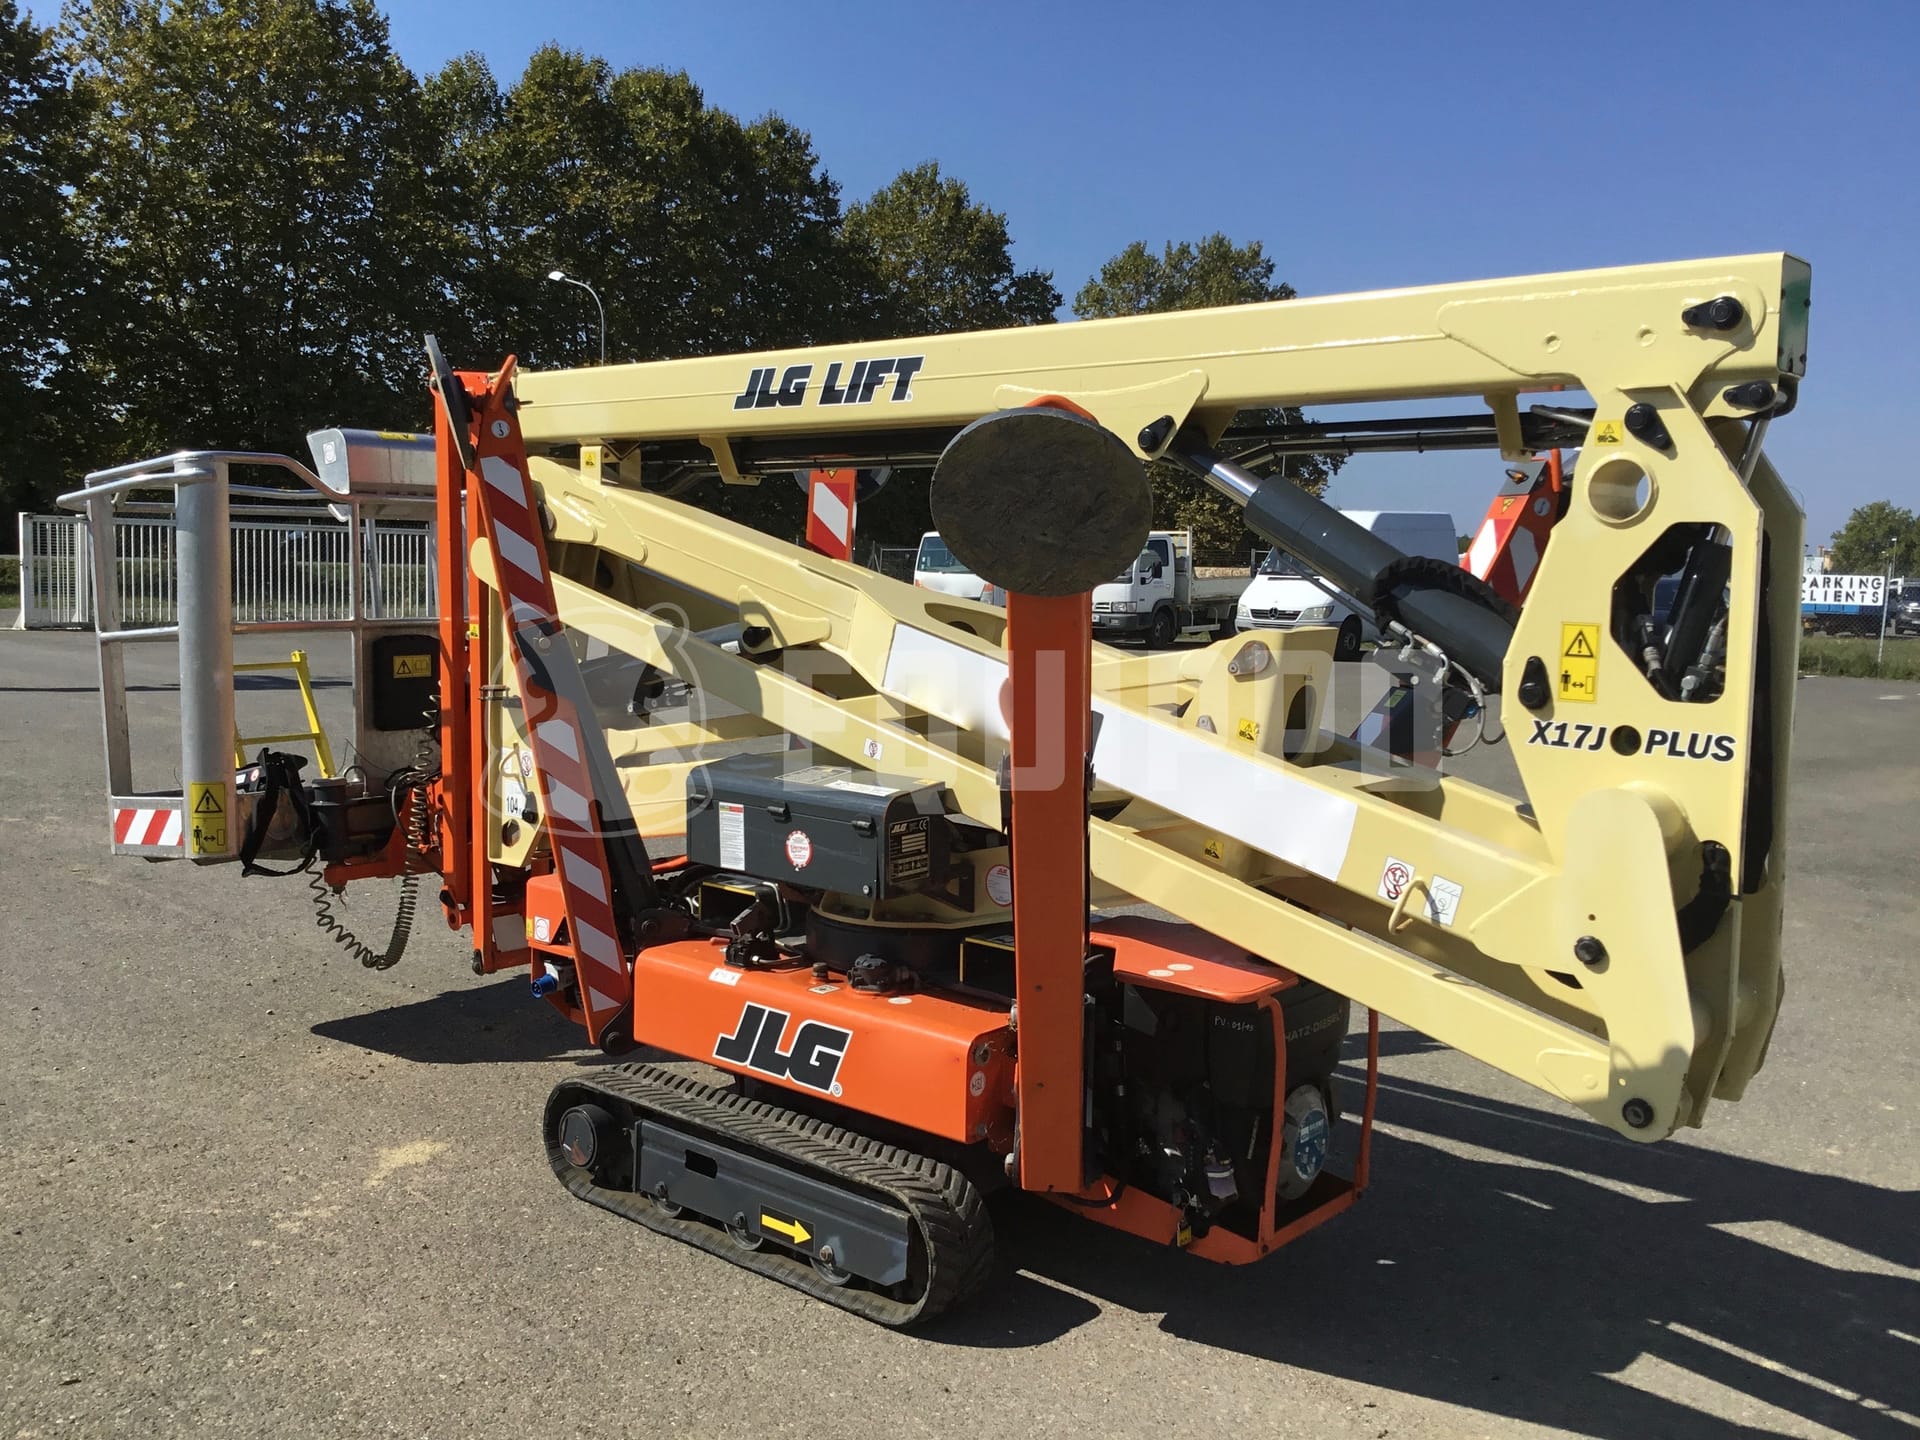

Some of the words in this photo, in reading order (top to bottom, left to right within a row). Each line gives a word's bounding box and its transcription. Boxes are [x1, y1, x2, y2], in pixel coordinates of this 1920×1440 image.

[733, 363, 813, 410] JLG
[818, 355, 925, 406] LIFT
[1529, 720, 1607, 751] X17J
[1644, 729, 1736, 762] PLUS
[713, 1002, 852, 1093] JLG
